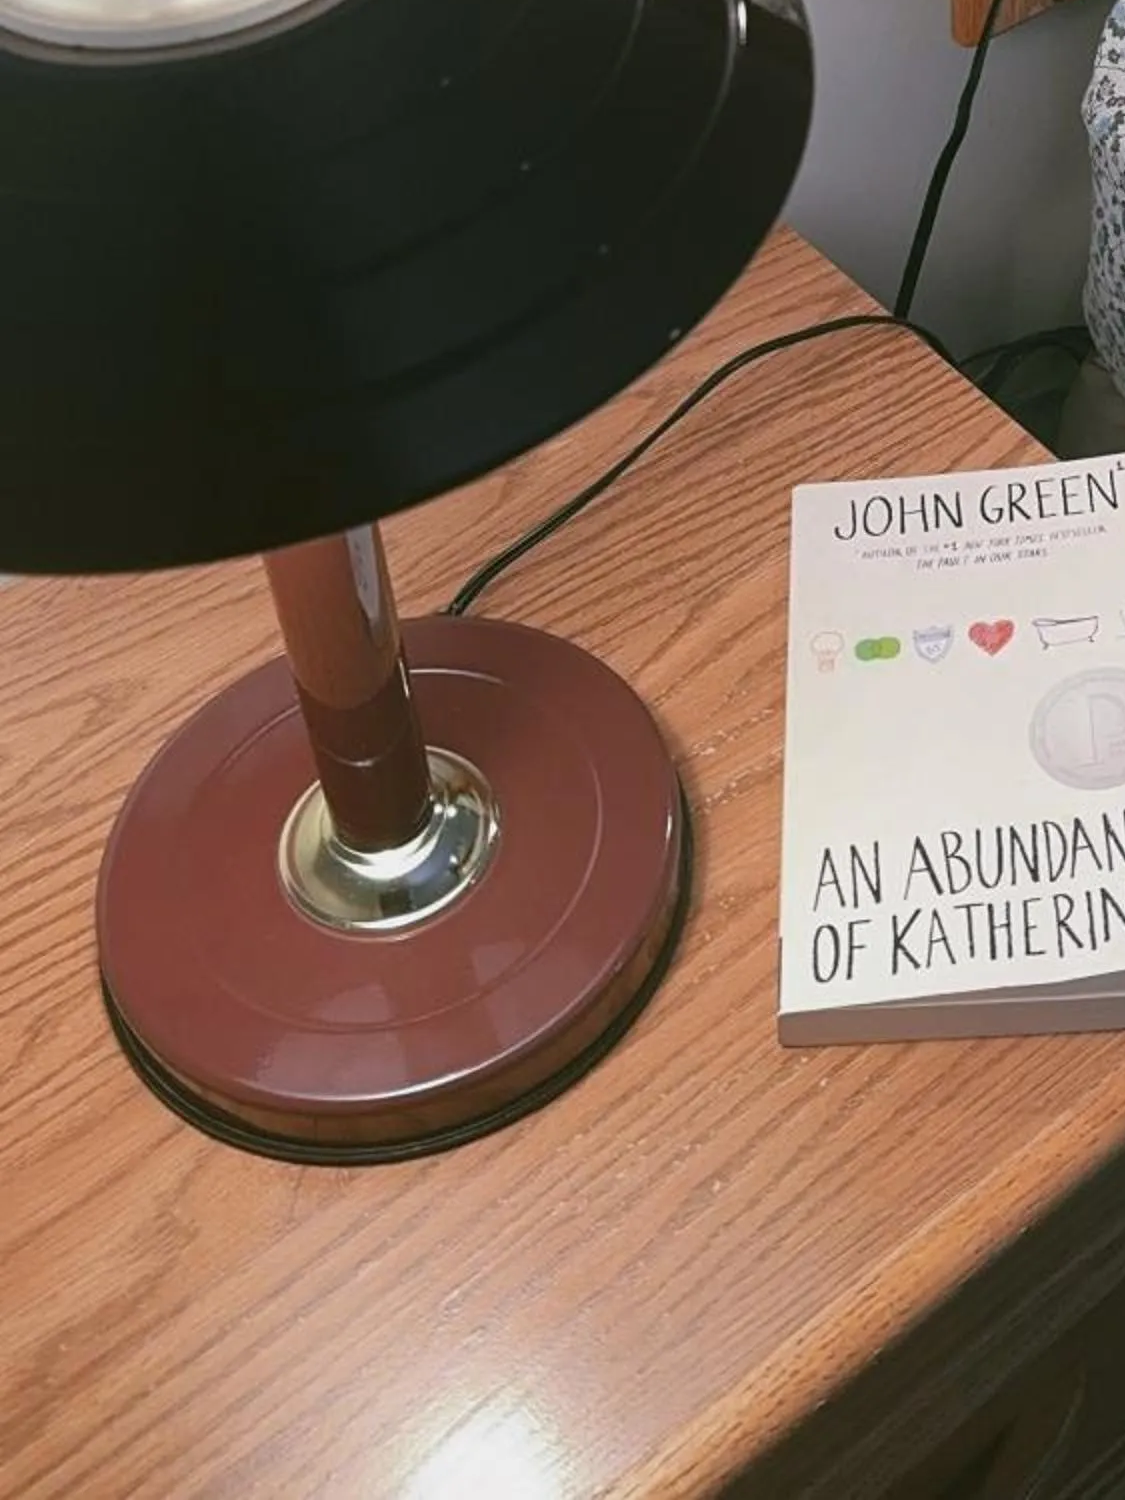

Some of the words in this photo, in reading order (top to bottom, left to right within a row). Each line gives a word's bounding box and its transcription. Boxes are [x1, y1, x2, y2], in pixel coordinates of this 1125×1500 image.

[834, 491, 963, 541] JOHN
[813, 841, 882, 912] AN
[812, 919, 873, 983] OF
